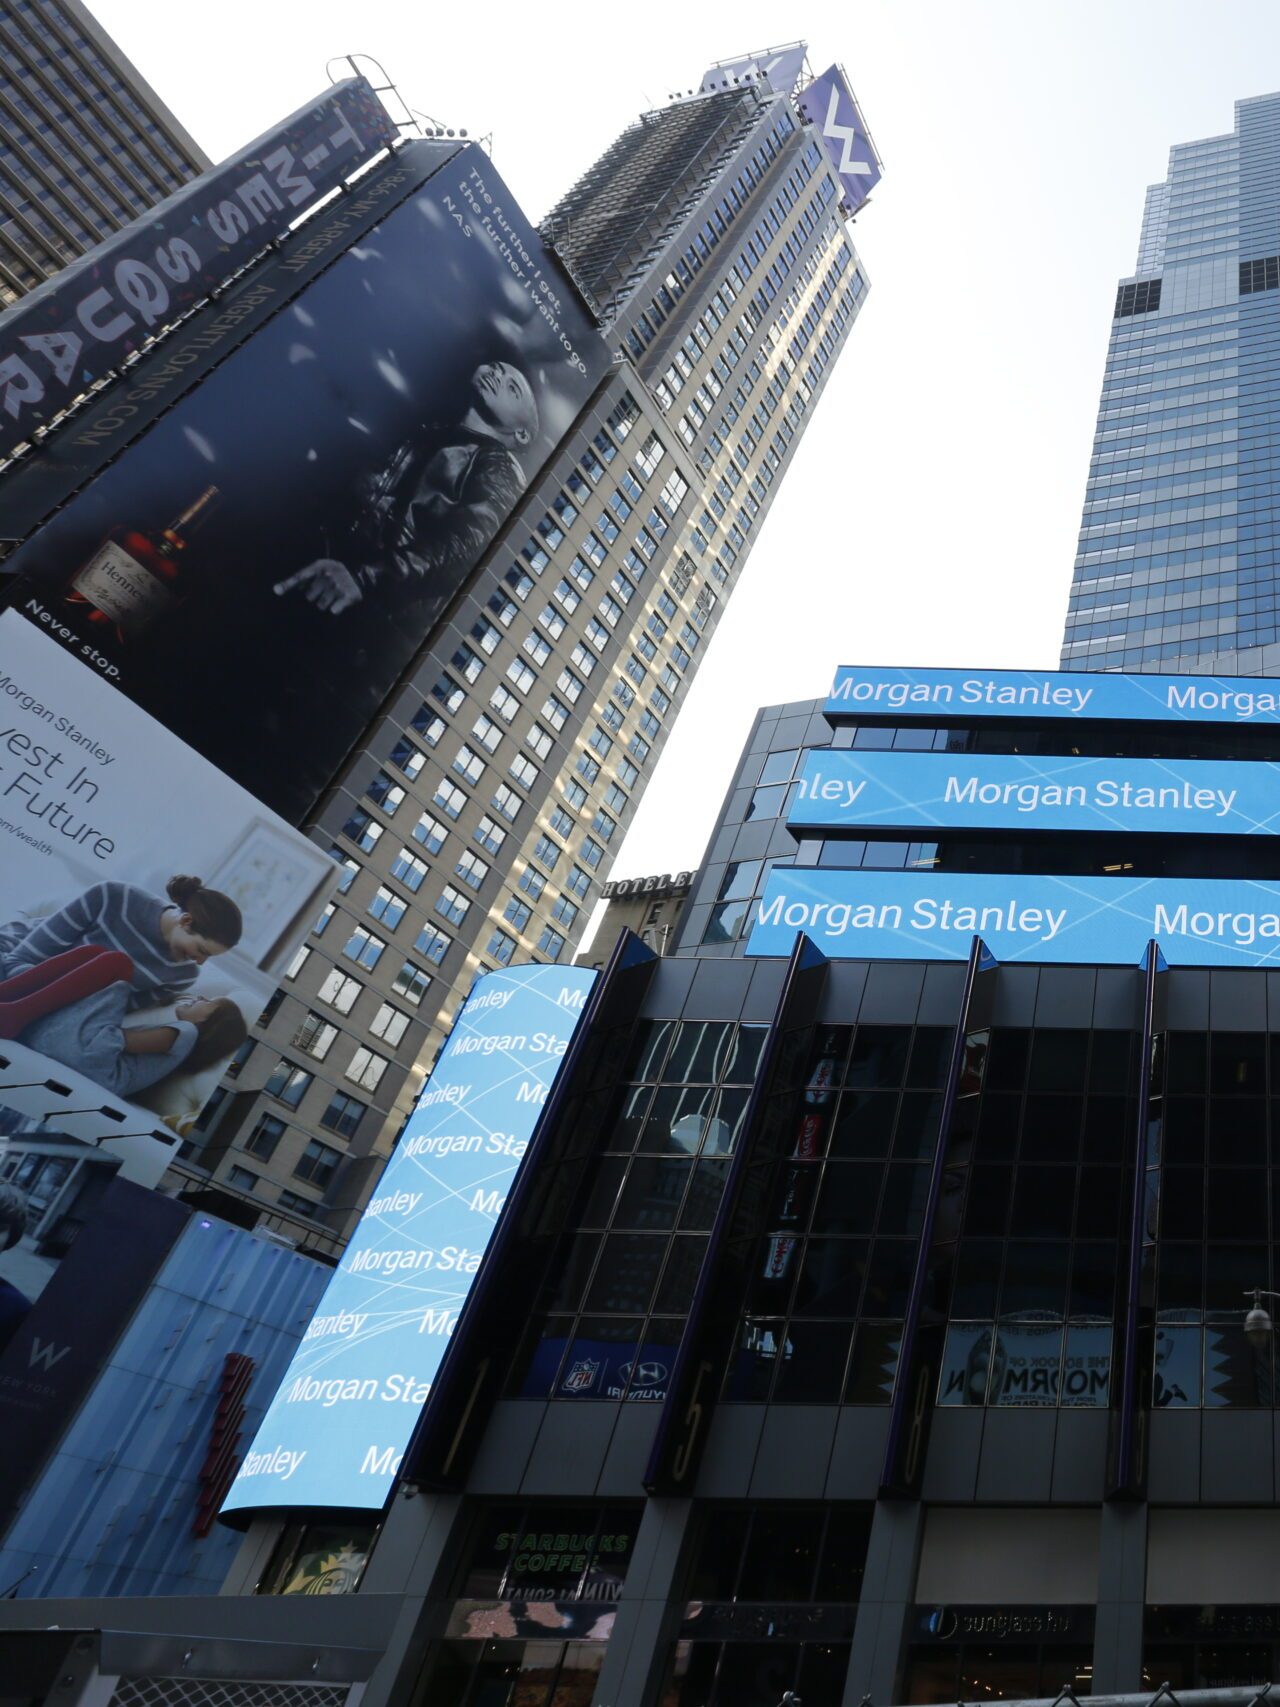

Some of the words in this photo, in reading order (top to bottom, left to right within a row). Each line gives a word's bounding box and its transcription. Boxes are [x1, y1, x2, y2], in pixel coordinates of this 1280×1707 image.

[823, 83, 872, 175] W
[207, 106, 366, 244] TIMES
[442, 196, 472, 238] NAS
[469, 167, 493, 204] The
[492, 207, 535, 268] further
[539, 280, 561, 314] get,
[459, 182, 482, 215] the
[482, 217, 525, 279] further
[530, 291, 560, 332] want
[559, 333, 572, 351] to
[571, 352, 588, 378] go.
[25, 598, 80, 643] Never
[81, 645, 122, 681] stop.
[829, 677, 953, 707] Morgan
[959, 679, 1094, 712] Stanley
[54, 717, 116, 766] Stanley
[66, 766, 100, 803] In
[944, 776, 1086, 812] Morgan
[1094, 780, 1237, 816] Stanley
[3, 771, 115, 860] Future
[601, 874, 672, 897] HOTEL
[757, 896, 901, 935] Morgan
[910, 899, 1067, 941] Stanley
[451, 1034, 525, 1057] Morgan
[402, 1135, 483, 1158] Morgan
[349, 1249, 433, 1275] Morgan
[28, 1336, 72, 1372] W
[287, 1376, 378, 1407] Morgan
[494, 1533, 630, 1552] STARBUCKS
